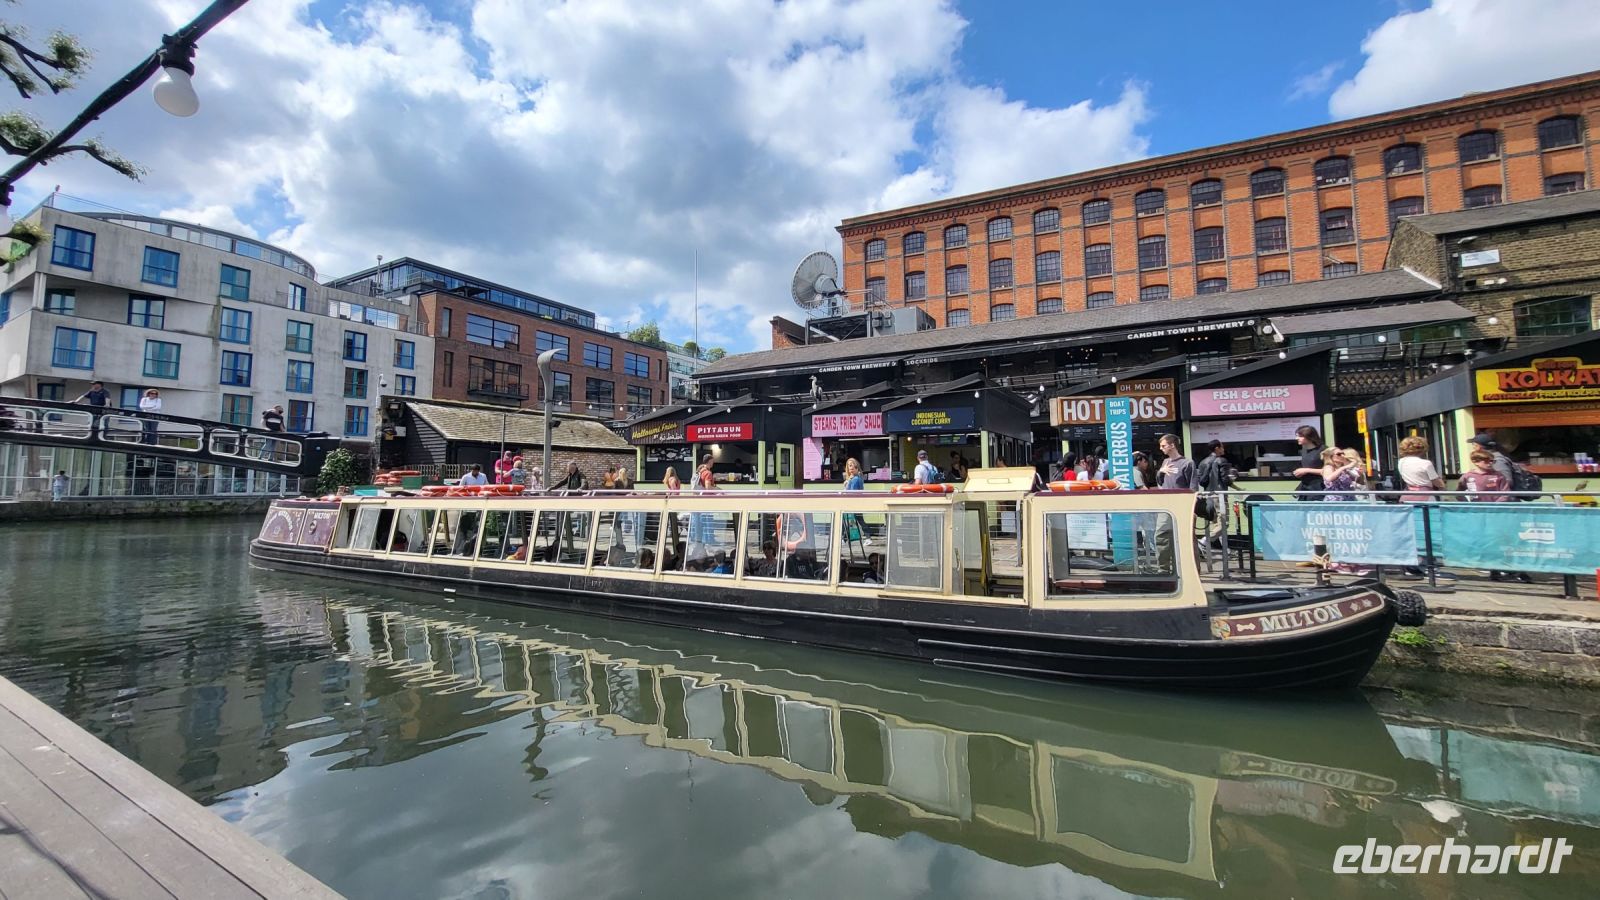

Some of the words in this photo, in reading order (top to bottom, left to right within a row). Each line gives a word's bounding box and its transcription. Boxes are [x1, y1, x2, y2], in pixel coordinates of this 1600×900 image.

[1127, 330, 1164, 340] CAMDEN
[1167, 326, 1195, 336] TOWN
[1197, 320, 1245, 332] BREWERY
[1150, 382, 1171, 390] DOG!
[1212, 390, 1238, 400] FISH
[1241, 390, 1250, 399] &
[1253, 388, 1290, 399] CHIPS
[1063, 399, 1104, 421] HOT
[1129, 396, 1168, 420] OGS
[1110, 408, 1127, 416] TRIPS
[1219, 401, 1286, 413] CALAMARI
[911, 418, 934, 426] COCONUT
[934, 417, 951, 425] CURRY
[915, 411, 946, 419] INDONESIAN
[697, 426, 741, 434] PITTABUN
[814, 416, 838, 432] STEAKS,
[840, 416, 857, 430] FRIES
[864, 415, 883, 430] SAUC
[1306, 512, 1363, 526] LONDON
[1301, 527, 1373, 541] WATERBUS
[1305, 541, 1369, 555] CPANY
[1259, 603, 1344, 633] MILTON
